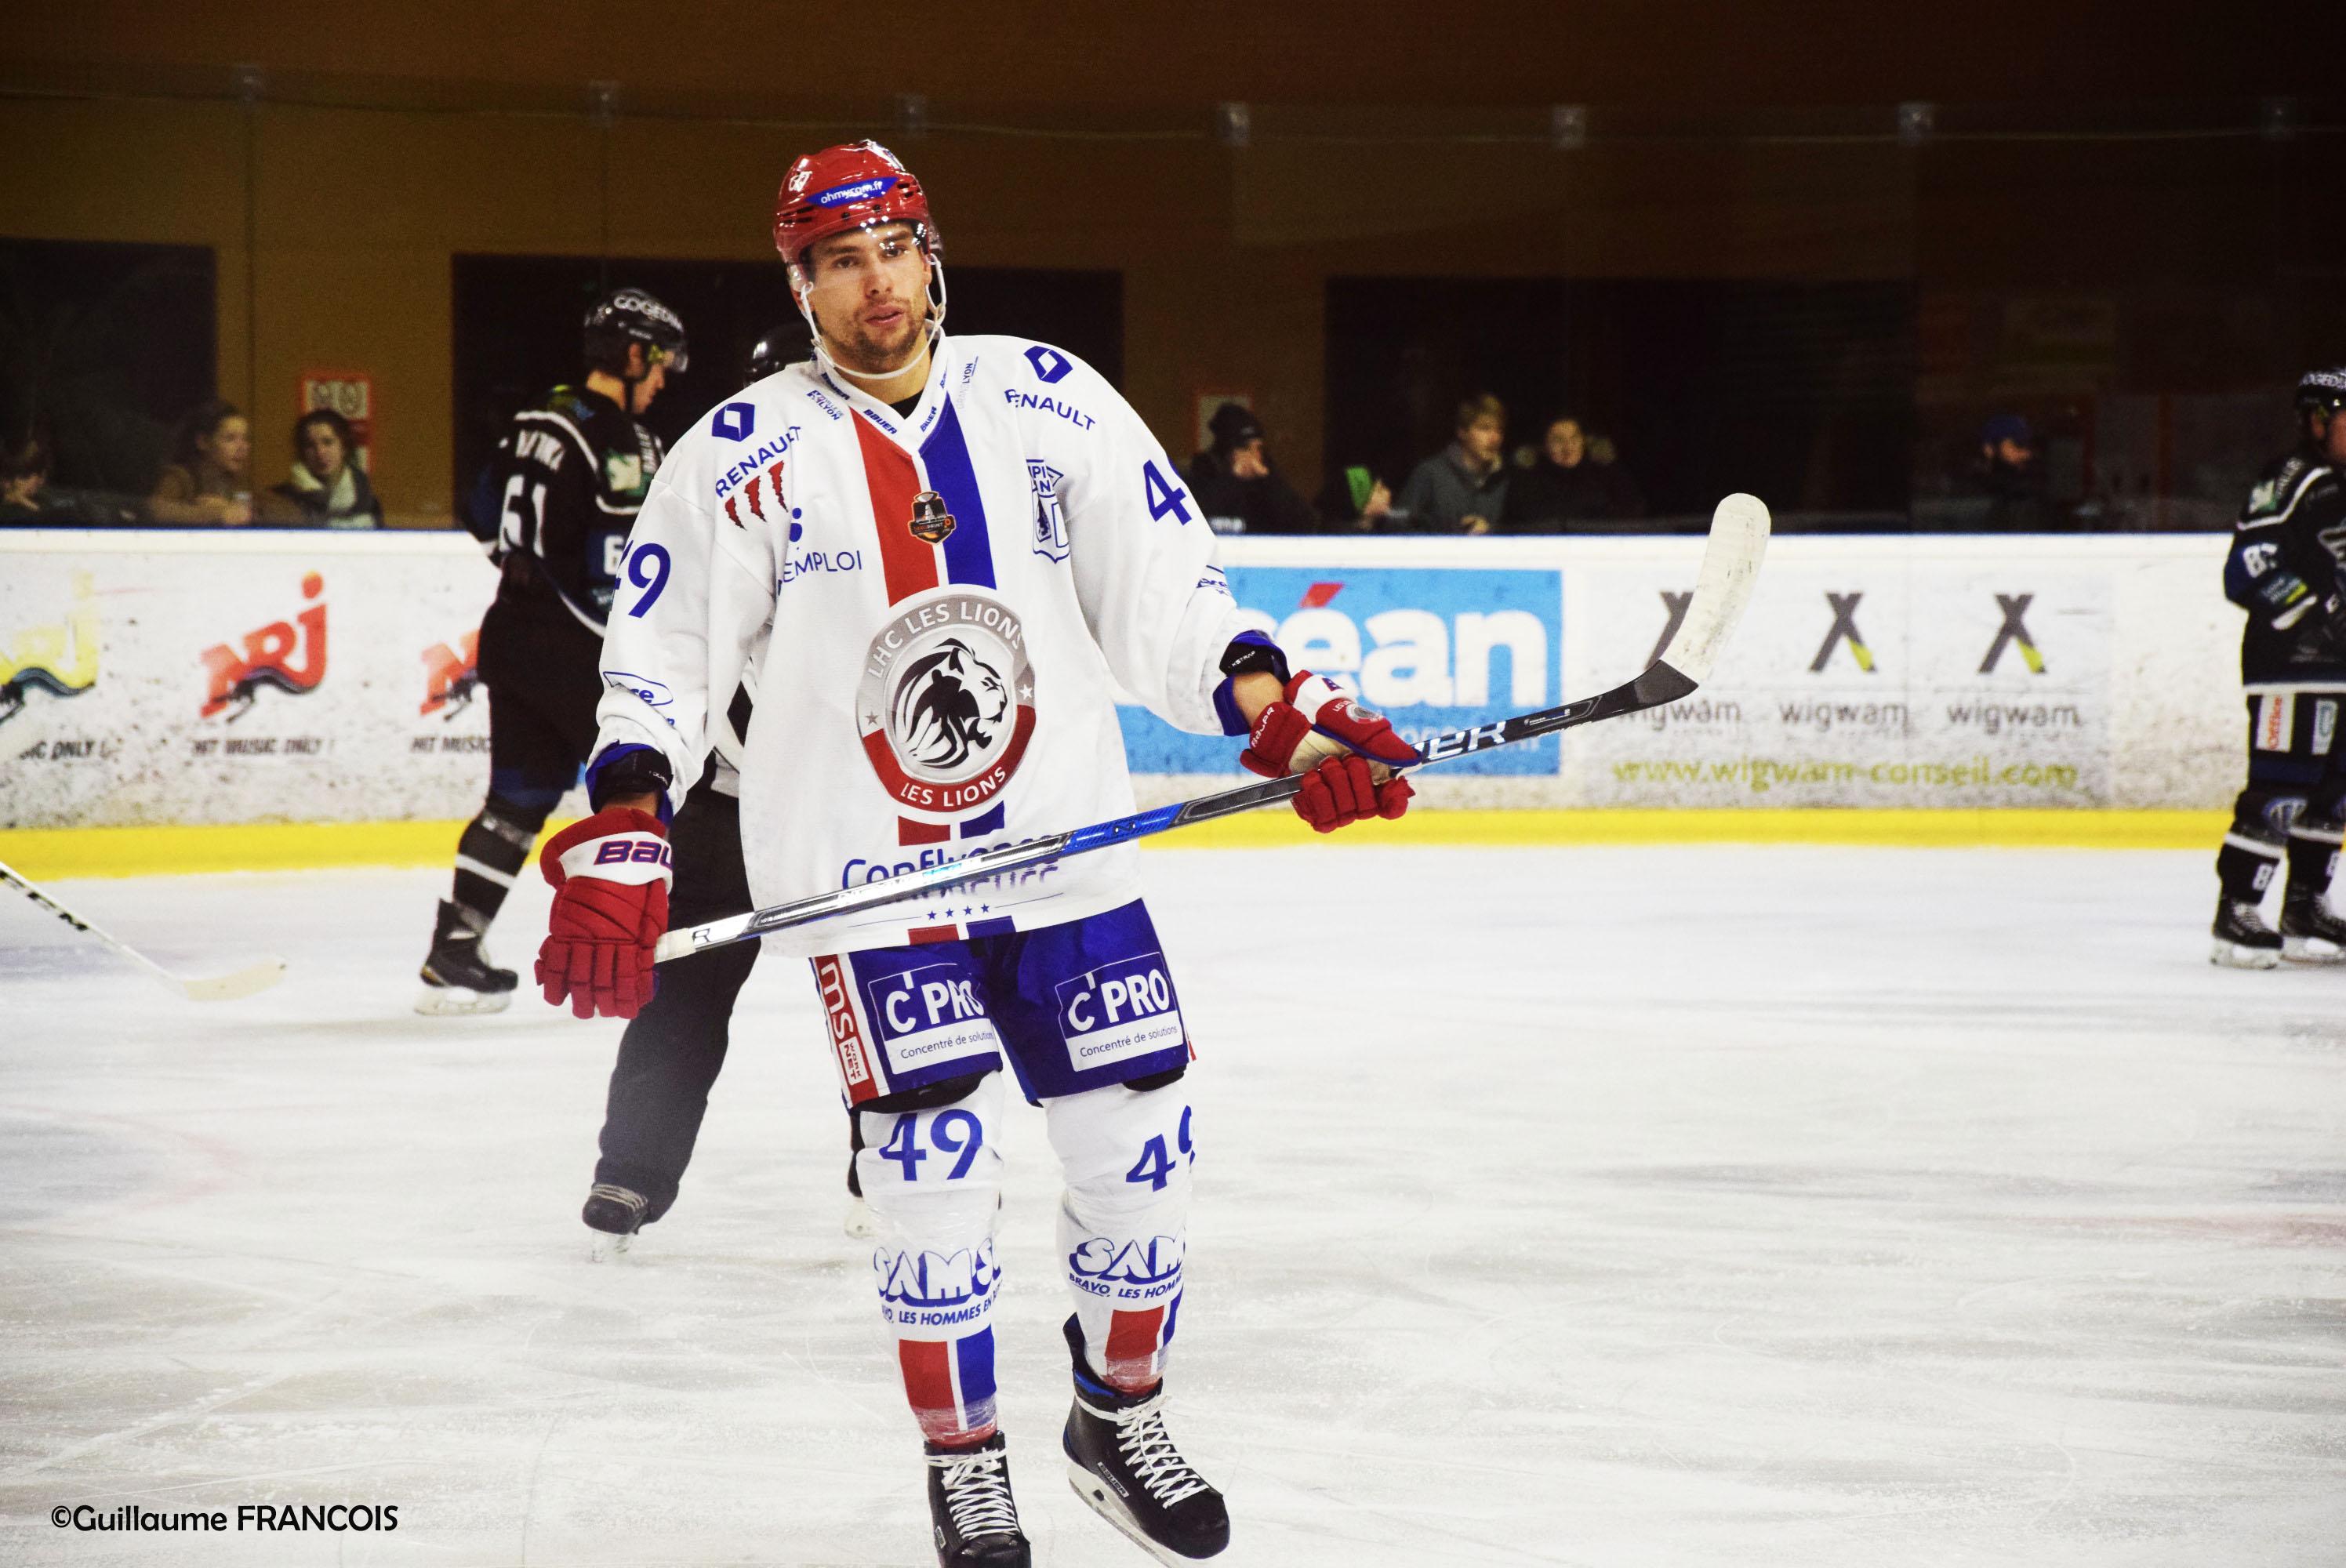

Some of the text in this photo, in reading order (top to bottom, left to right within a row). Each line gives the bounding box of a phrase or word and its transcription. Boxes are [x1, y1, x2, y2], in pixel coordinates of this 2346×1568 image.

[962, 363, 973, 383] LYON
[819, 401, 840, 420] LYON
[863, 408, 898, 434] BAUER
[1004, 389, 1096, 430] RNAULT
[1142, 459, 1193, 526] 4
[868, 630, 903, 679] LHC
[905, 603, 951, 634] LES
[1618, 698, 1741, 731] gwam
[1779, 698, 1908, 733] wigwam
[1947, 697, 2080, 735] wigwam
[224, 739, 277, 755] MUSIC
[901, 766, 1007, 808] LES LIONS
[1612, 753, 2078, 793] www.wigwam-conseil.com
[900, 1036, 953, 1059] Concentré
[956, 1035, 967, 1047] de
[1080, 1025, 1178, 1058] Concentré de solutions
[878, 1109, 983, 1181] 49
[1117, 1287, 1141, 1299] LES
[899, 1310, 917, 1325] LES
[920, 1303, 981, 1327] HOMMES
